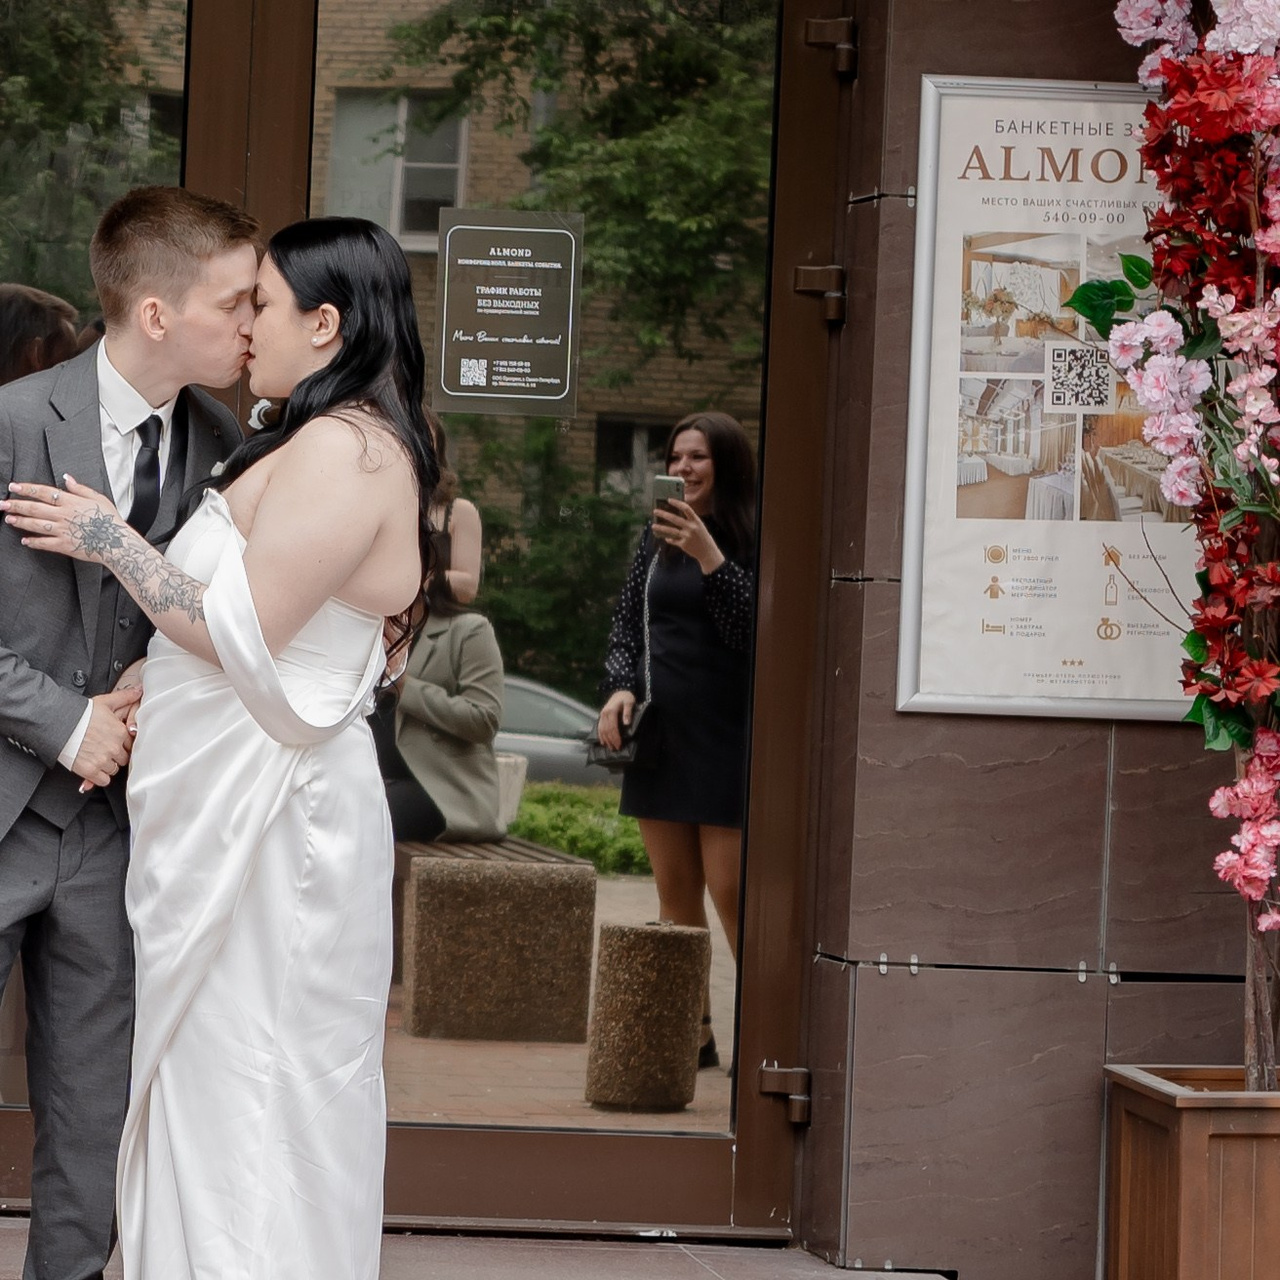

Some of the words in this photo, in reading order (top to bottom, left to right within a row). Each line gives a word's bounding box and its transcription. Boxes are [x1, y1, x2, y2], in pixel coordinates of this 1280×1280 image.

[995, 119, 1114, 137] БАНКЕТНЫЕ
[981, 196, 1018, 207] МЕСТО
[1022, 198, 1061, 208] ВАШИХ
[1065, 199, 1137, 209] СЧАСТЛИВЫХ
[1042, 211, 1125, 224] 540-09-00
[489, 247, 532, 257] ALMOND
[475, 285, 508, 295] ГРАФИК
[509, 287, 542, 297] РАБОТЫ
[477, 298, 492, 307] БЕЗ
[493, 299, 539, 309] ВЫХОДНЫХ
